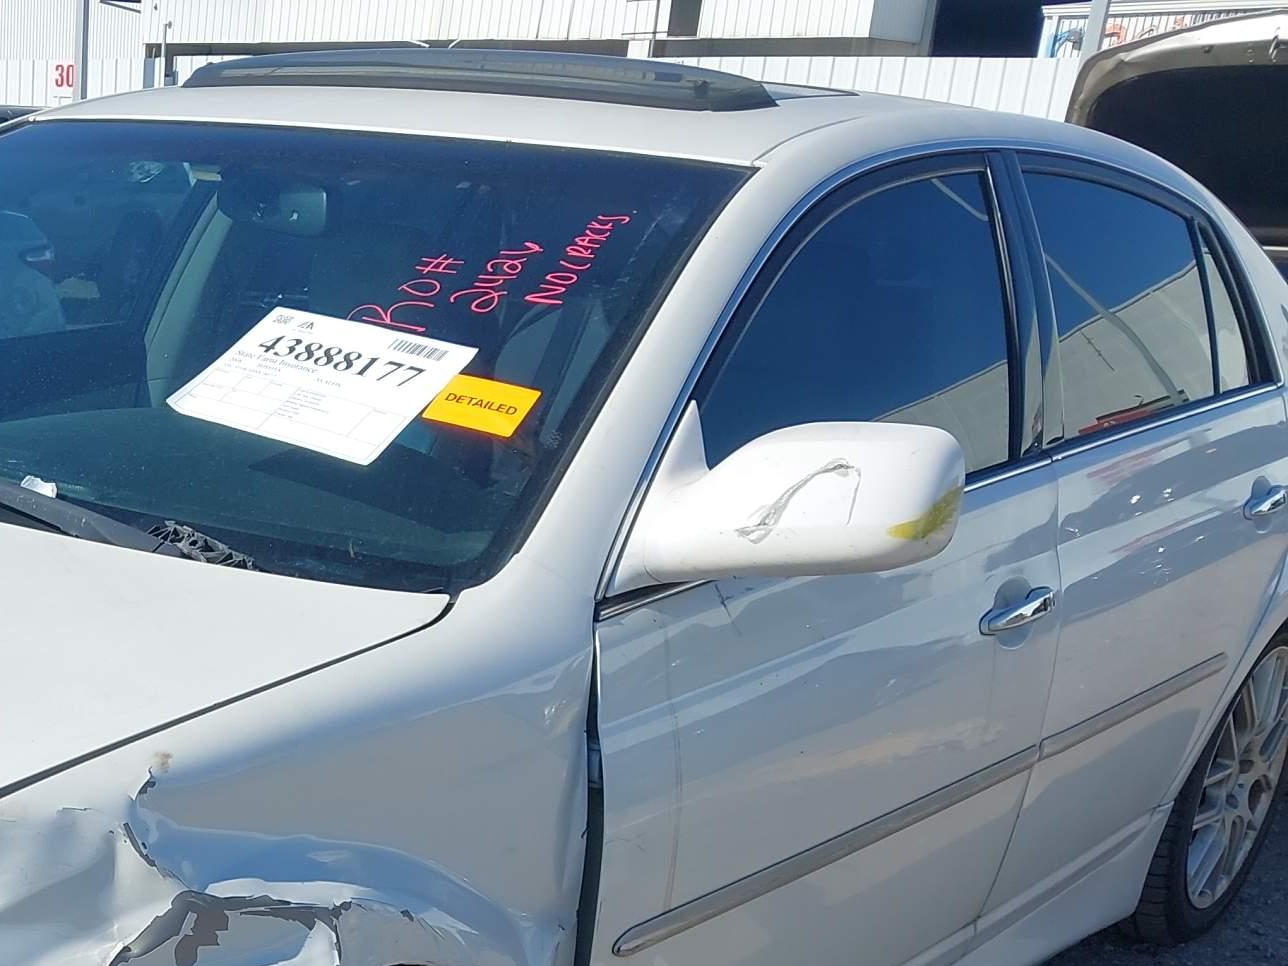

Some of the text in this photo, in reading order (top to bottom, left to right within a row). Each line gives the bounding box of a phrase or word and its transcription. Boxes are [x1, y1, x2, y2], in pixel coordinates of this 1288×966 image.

[55, 64, 75, 88] 30
[258, 335, 427, 387] 43888177
[444, 392, 518, 416] DETAILED
